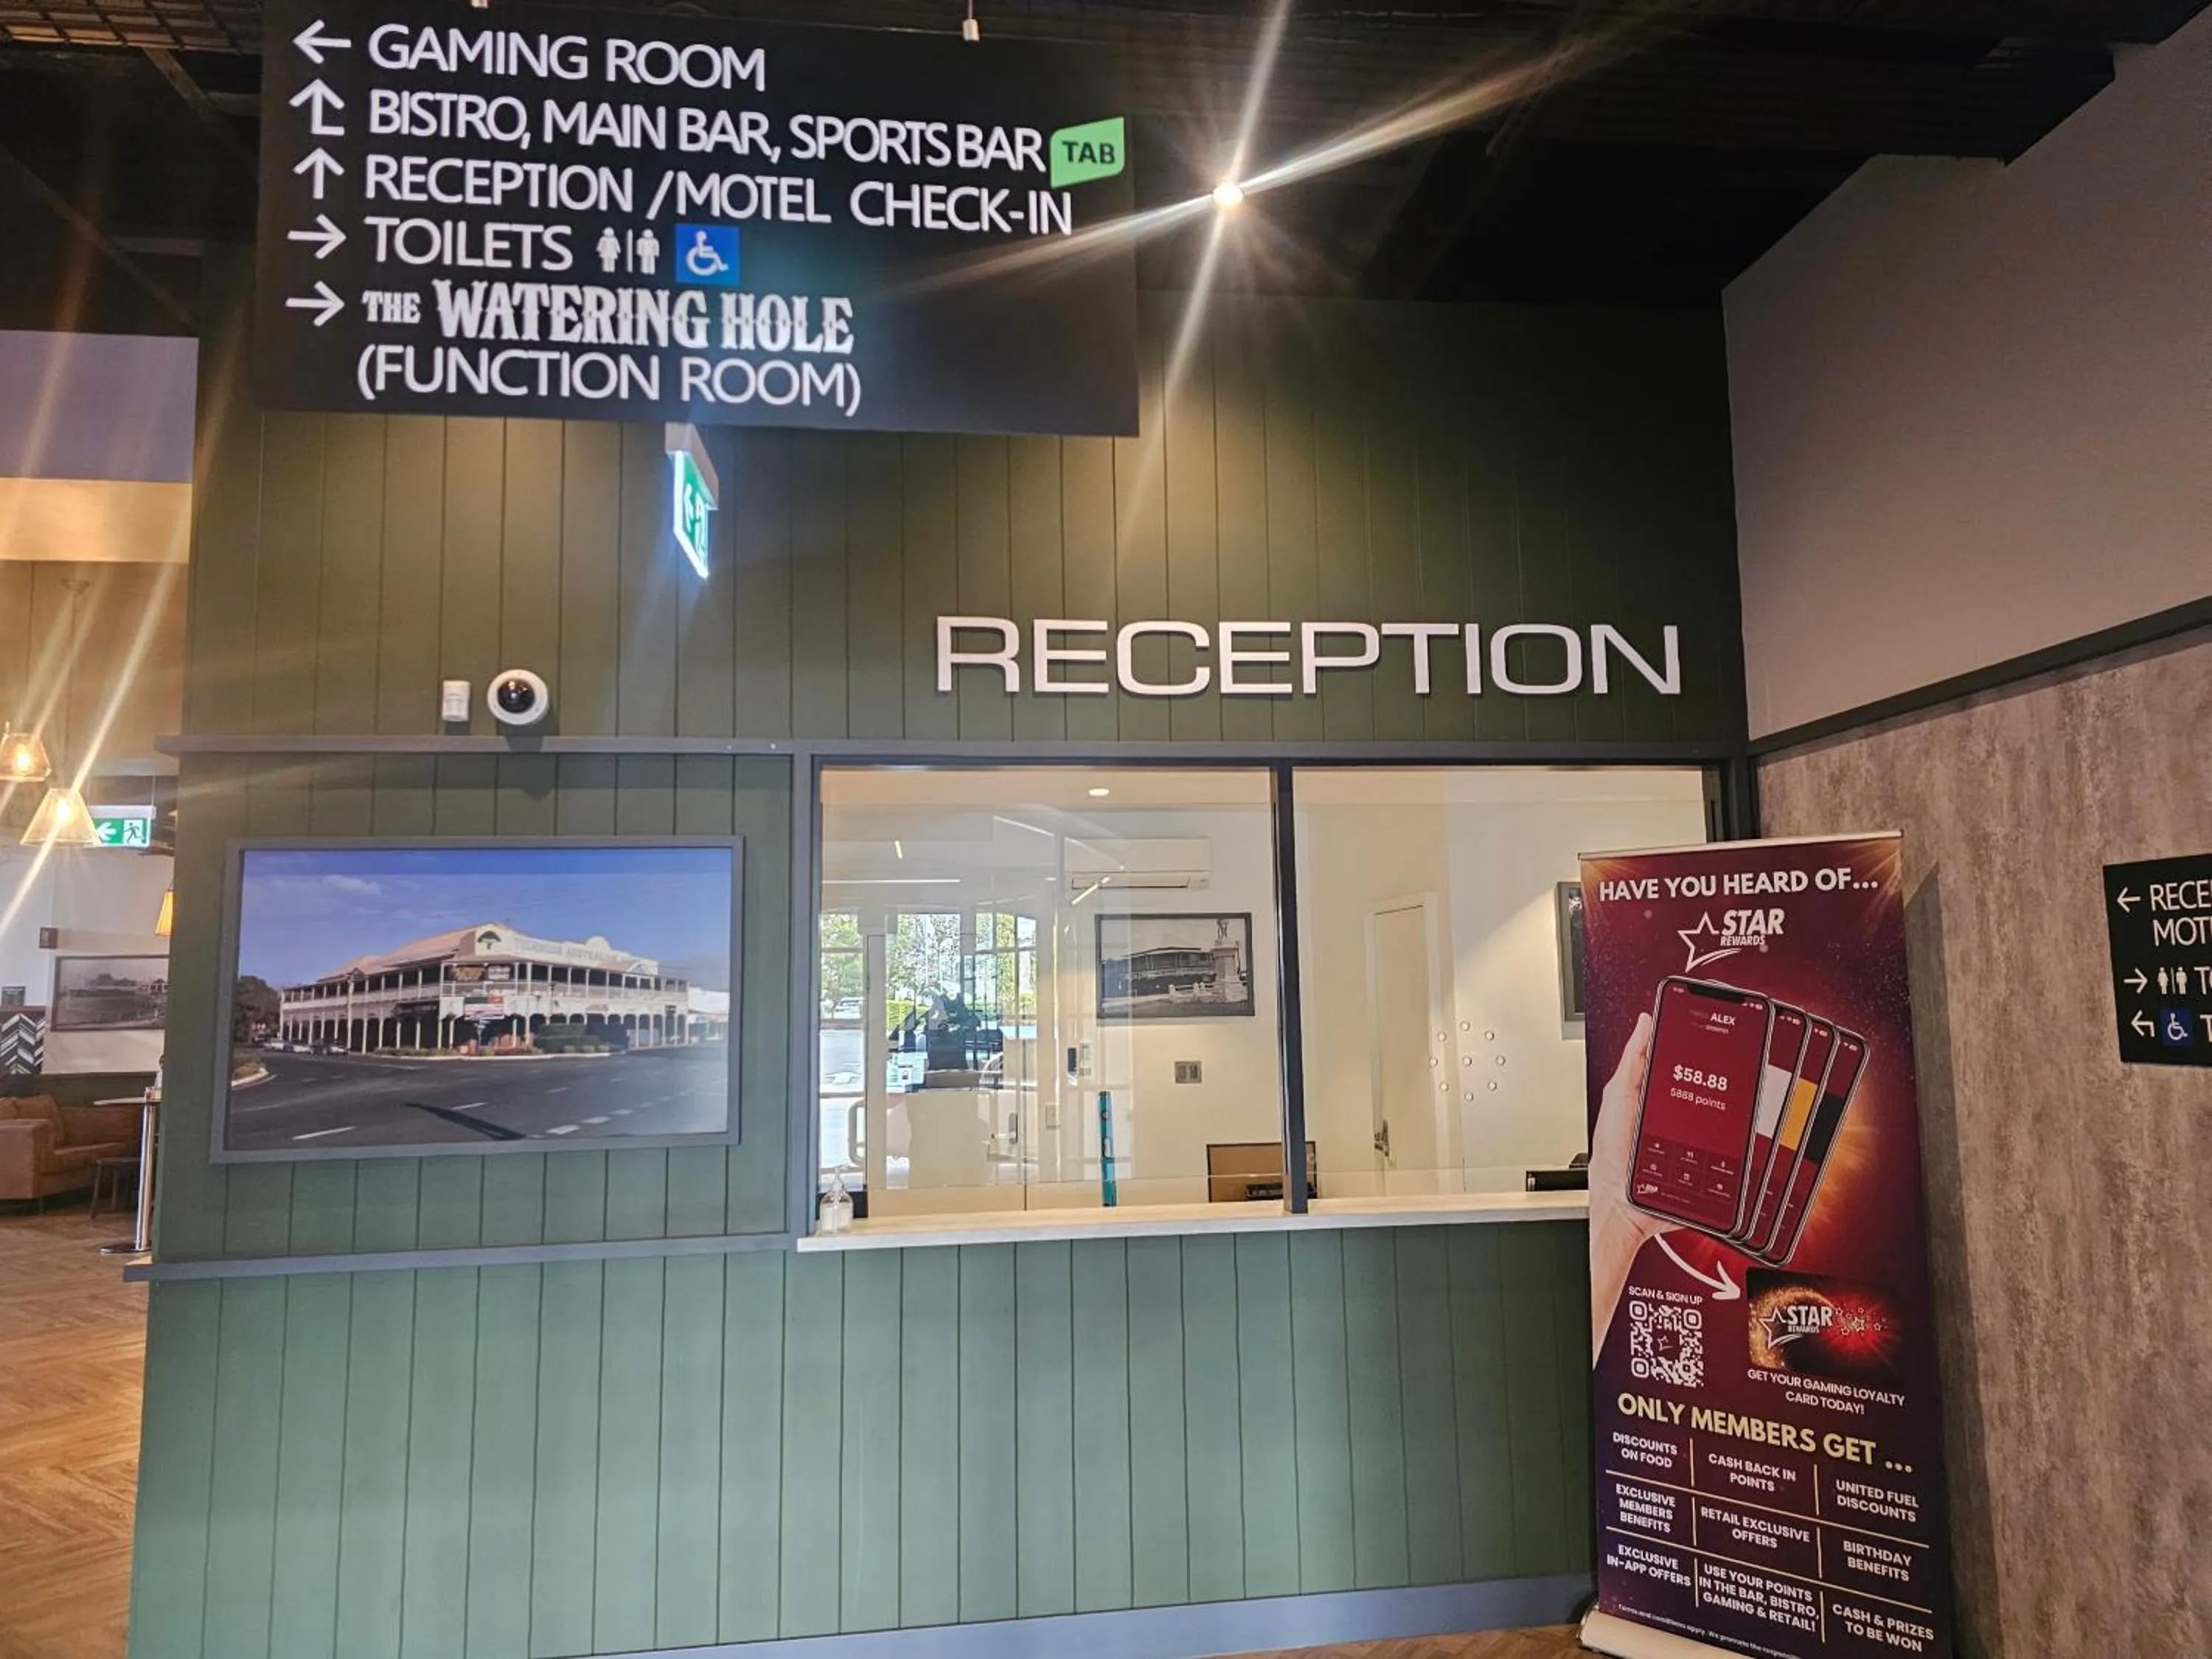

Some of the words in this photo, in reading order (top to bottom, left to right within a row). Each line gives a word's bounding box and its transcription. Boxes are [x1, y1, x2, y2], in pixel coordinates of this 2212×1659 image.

[369, 24, 588, 80] GAMING
[606, 39, 765, 91] ROOM
[370, 89, 531, 150] BISTRO,
[543, 100, 666, 150] MAIN
[678, 107, 781, 164] BAR,
[789, 114, 951, 168] SPORTS
[958, 125, 1046, 173] BAR
[1062, 140, 1116, 165] TAB
[366, 154, 633, 212] RECEPTION
[850, 181, 1072, 236] CHECK-IN
[364, 216, 574, 271] TOILETS
[362, 291, 420, 324] THE
[433, 279, 709, 348] WATERING
[721, 293, 855, 355] HOLE
[358, 344, 660, 401] (FUNCTION
[681, 358, 861, 417] ROOM)
[936, 616, 1680, 696] RECEPTION
[1599, 878, 1659, 902] HAVE
[1664, 875, 1717, 898] YOU
[1724, 872, 1809, 896] HEARD
[2149, 880, 2212, 911] RECE
[1721, 908, 1785, 936] STAR
[2152, 917, 2212, 947] MOT
[1720, 935, 1766, 947] REWARDS
[1711, 1012, 1736, 1026] ALEX
[1673, 1064, 1728, 1091] $58.88
[1696, 1096, 1726, 1110] points
[1629, 1285, 1655, 1298] SCAN
[1656, 1290, 1664, 1300] &
[1666, 1291, 1688, 1304] SIGN
[1689, 1295, 1703, 1305] UP
[1787, 1305, 1833, 1326] STAR
[1747, 1368, 1768, 1382] GET
[1770, 1372, 1801, 1388] YOUR
[1803, 1378, 1851, 1397] GAMING
[1854, 1387, 1905, 1407] LOYALTY
[1785, 1391, 1819, 1407] CARD
[1820, 1397, 1865, 1415] TODAY!
[1613, 1431, 1677, 1455] DISCOUNTS
[1618, 1393, 1685, 1426] ONLY
[1691, 1405, 1816, 1453] MEMBERS
[1823, 1433, 1877, 1465] GET
[1621, 1447, 1638, 1461] ON
[1640, 1450, 1673, 1468] FOOD
[1708, 1453, 1743, 1470] CASH
[1745, 1461, 1781, 1478] BACK
[1782, 1469, 1796, 1482] IN
[1615, 1483, 1676, 1508] EXCLUSIVE
[1730, 1472, 1775, 1492] POINTS
[1836, 1479, 1885, 1500] UNITED
[1887, 1490, 1919, 1509] FUEL
[1618, 1498, 1673, 1520] MEMBERS
[1620, 1511, 1671, 1533] BENEFITS
[1837, 1495, 1916, 1523] DISCOUNTS
[1701, 1506, 1741, 1526] RETAIL
[1742, 1517, 1810, 1543] EXCLUSIVE
[1732, 1528, 1778, 1549] OFFERS
[1618, 1543, 1679, 1570] EXCLUSIVE
[1843, 1540, 1912, 1567] BIRTHDAY
[1607, 1554, 1646, 1574] IN-APP
[1649, 1566, 1691, 1587] OFFERS
[1704, 1564, 1728, 1579] USE
[1728, 1570, 1764, 1588] YOUR
[1766, 1580, 1813, 1602] POINTS
[1847, 1557, 1910, 1582] BENEFITS
[1699, 1576, 1711, 1589] IN
[1714, 1579, 1736, 1596] THE
[1739, 1586, 1767, 1606] BAR,
[1770, 1596, 1819, 1619] BISTRO,
[1703, 1592, 1754, 1614] GAMING
[1756, 1605, 1767, 1618] &
[1769, 1610, 1816, 1632] RETAIL!
[1832, 1604, 1871, 1623] CASH
[1873, 1614, 1885, 1627] &
[1887, 1617, 1934, 1641] PRIZES
[1845, 1621, 1864, 1636] TO
[1866, 1627, 1883, 1641] BE
[1885, 1632, 1923, 1652] WON
